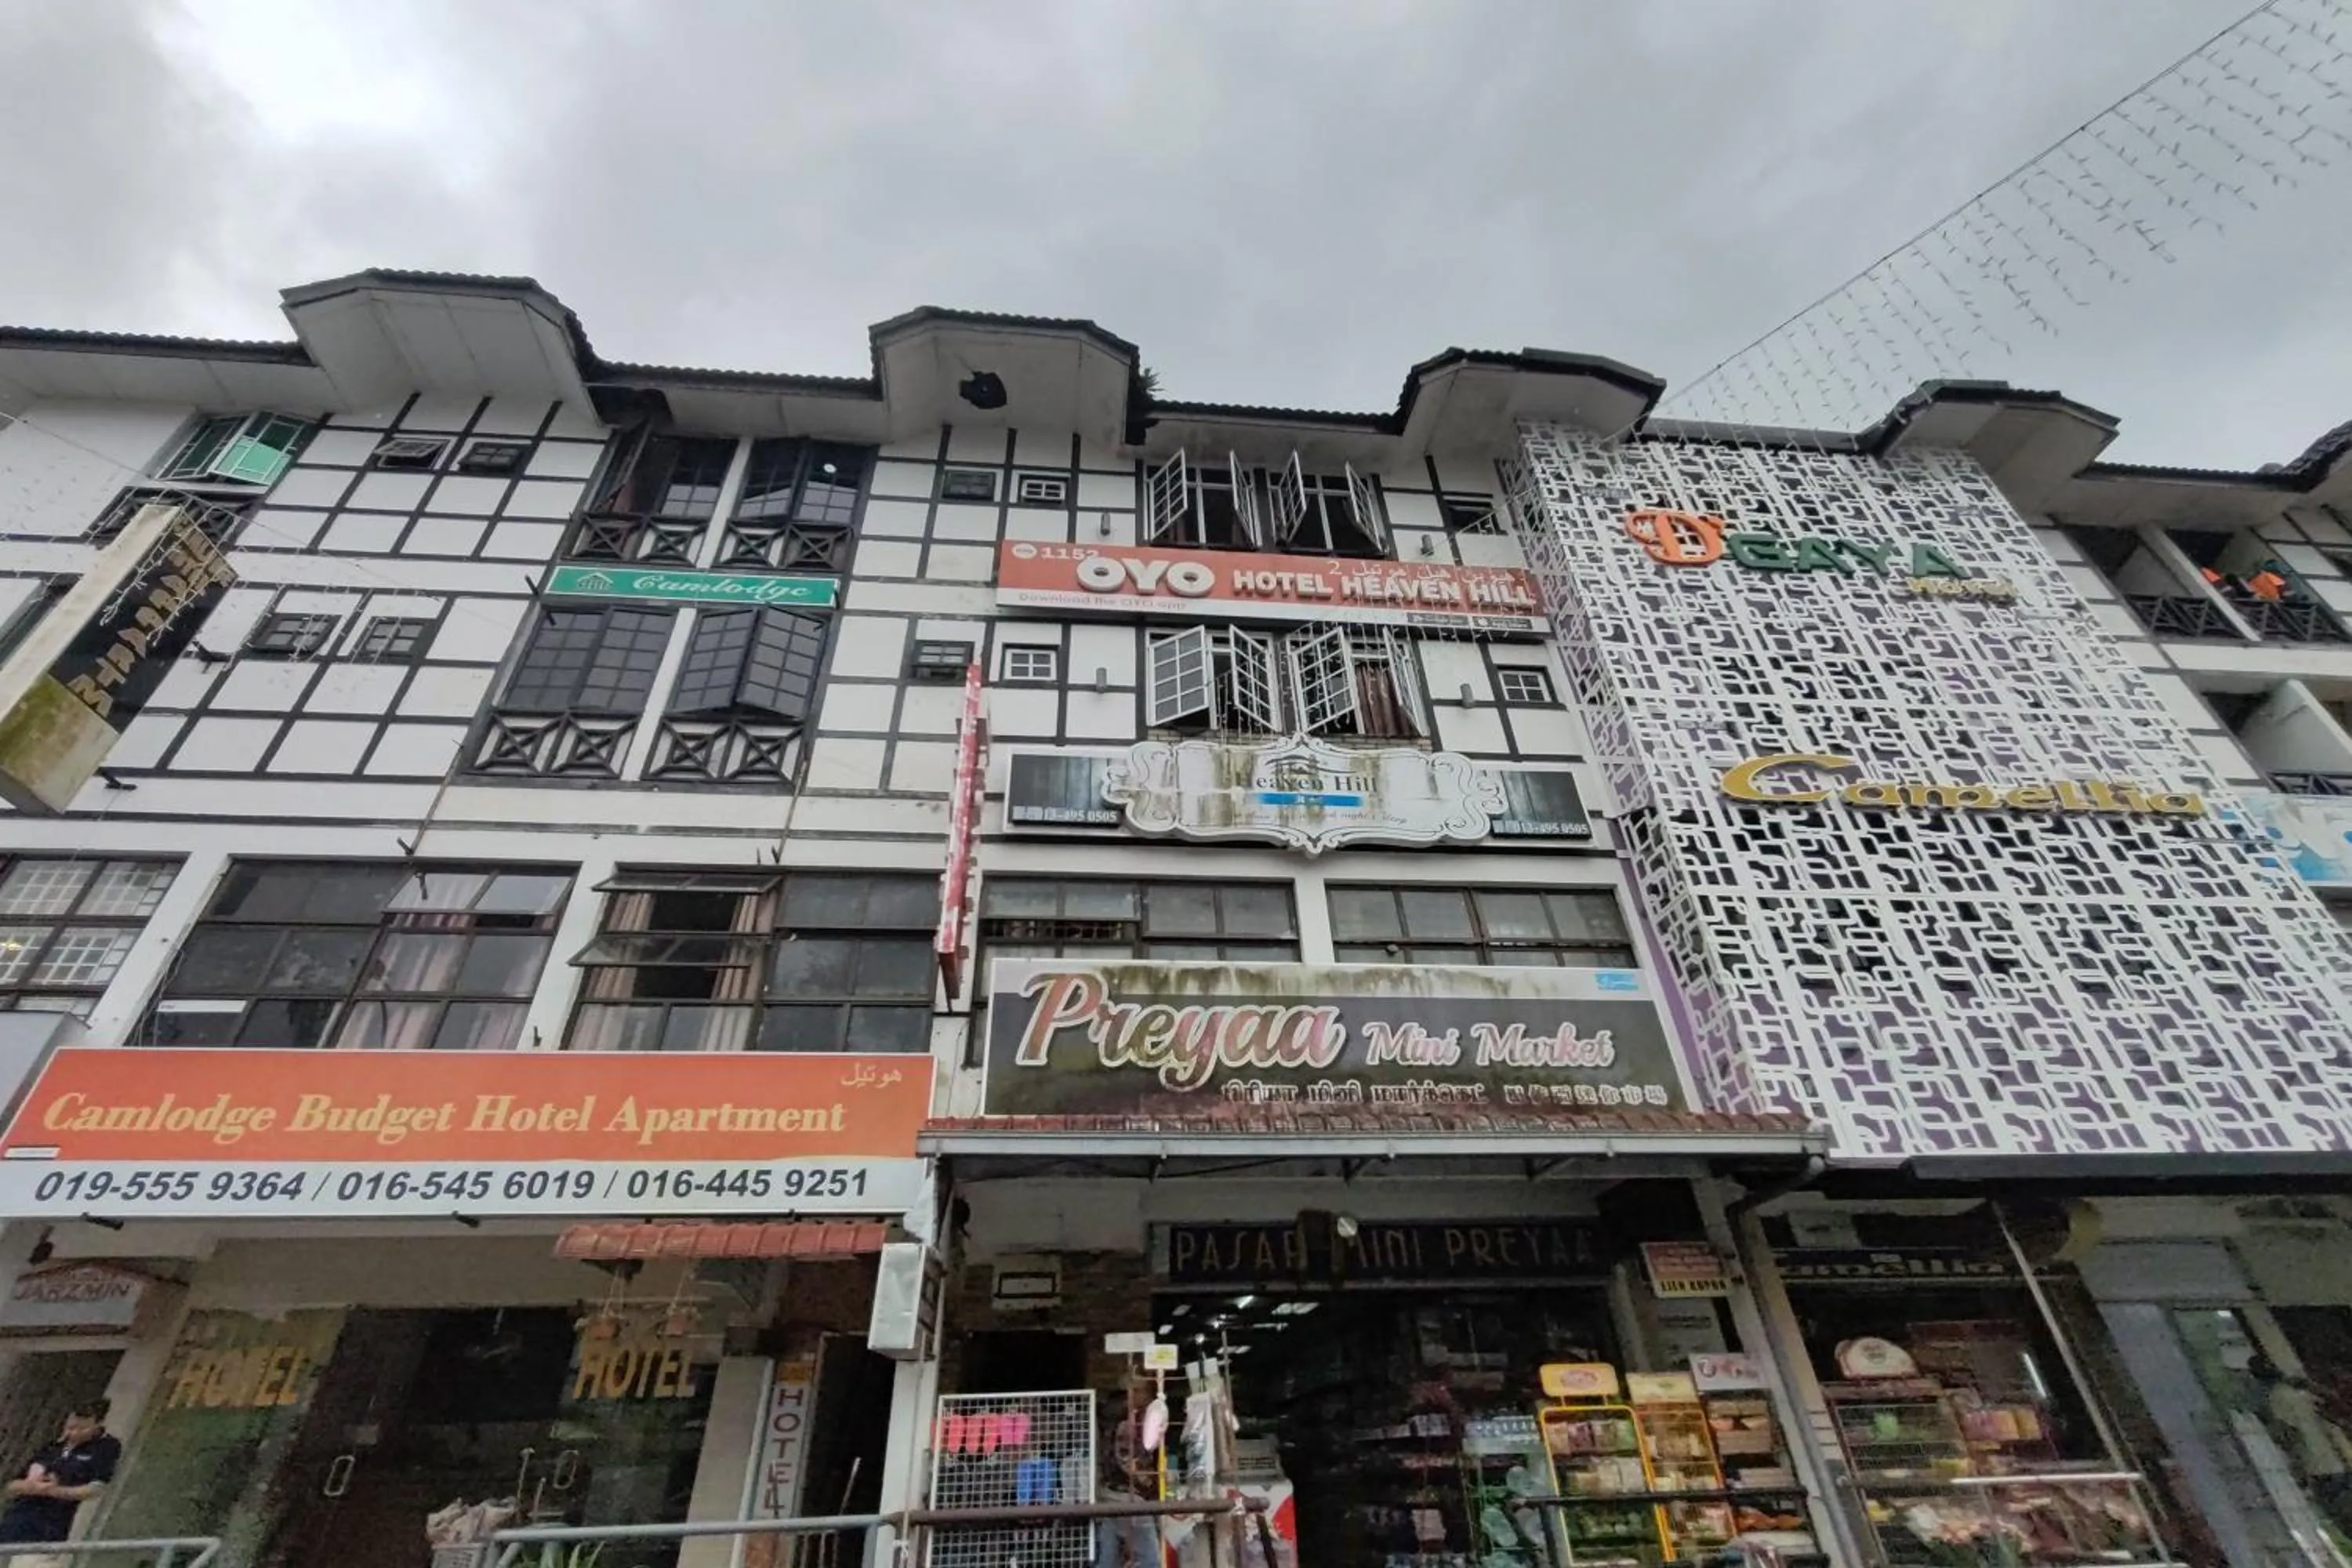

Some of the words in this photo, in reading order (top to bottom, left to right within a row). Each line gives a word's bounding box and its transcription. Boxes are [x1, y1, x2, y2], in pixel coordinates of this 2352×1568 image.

[632, 575, 812, 602] Camlodge
[1076, 557, 1216, 597] OYO
[1233, 569, 1334, 597] HOTEL
[1341, 575, 1462, 604] HEAVEN
[1468, 580, 1535, 609] HILL
[1334, 774, 1379, 792] Hill
[1722, 753, 2205, 816] Camellia
[1016, 971, 1347, 1092] Preyaa
[1361, 1022, 1461, 1066] Mini
[1470, 1022, 1615, 1067] Market
[43, 1092, 278, 1145] Camlodge
[285, 1093, 458, 1145] Budget
[464, 1094, 597, 1132] Hotel
[603, 1095, 848, 1145] Apartment
[34, 1170, 199, 1202] 019-555
[205, 1170, 307, 1202] 9364
[336, 1170, 494, 1202] 016-545
[502, 1170, 596, 1200] 6019
[626, 1168, 772, 1199] 016-445
[783, 1168, 867, 1198] 9251
[572, 1345, 697, 1399] HOTEL
[764, 1388, 804, 1510] HOTEL
